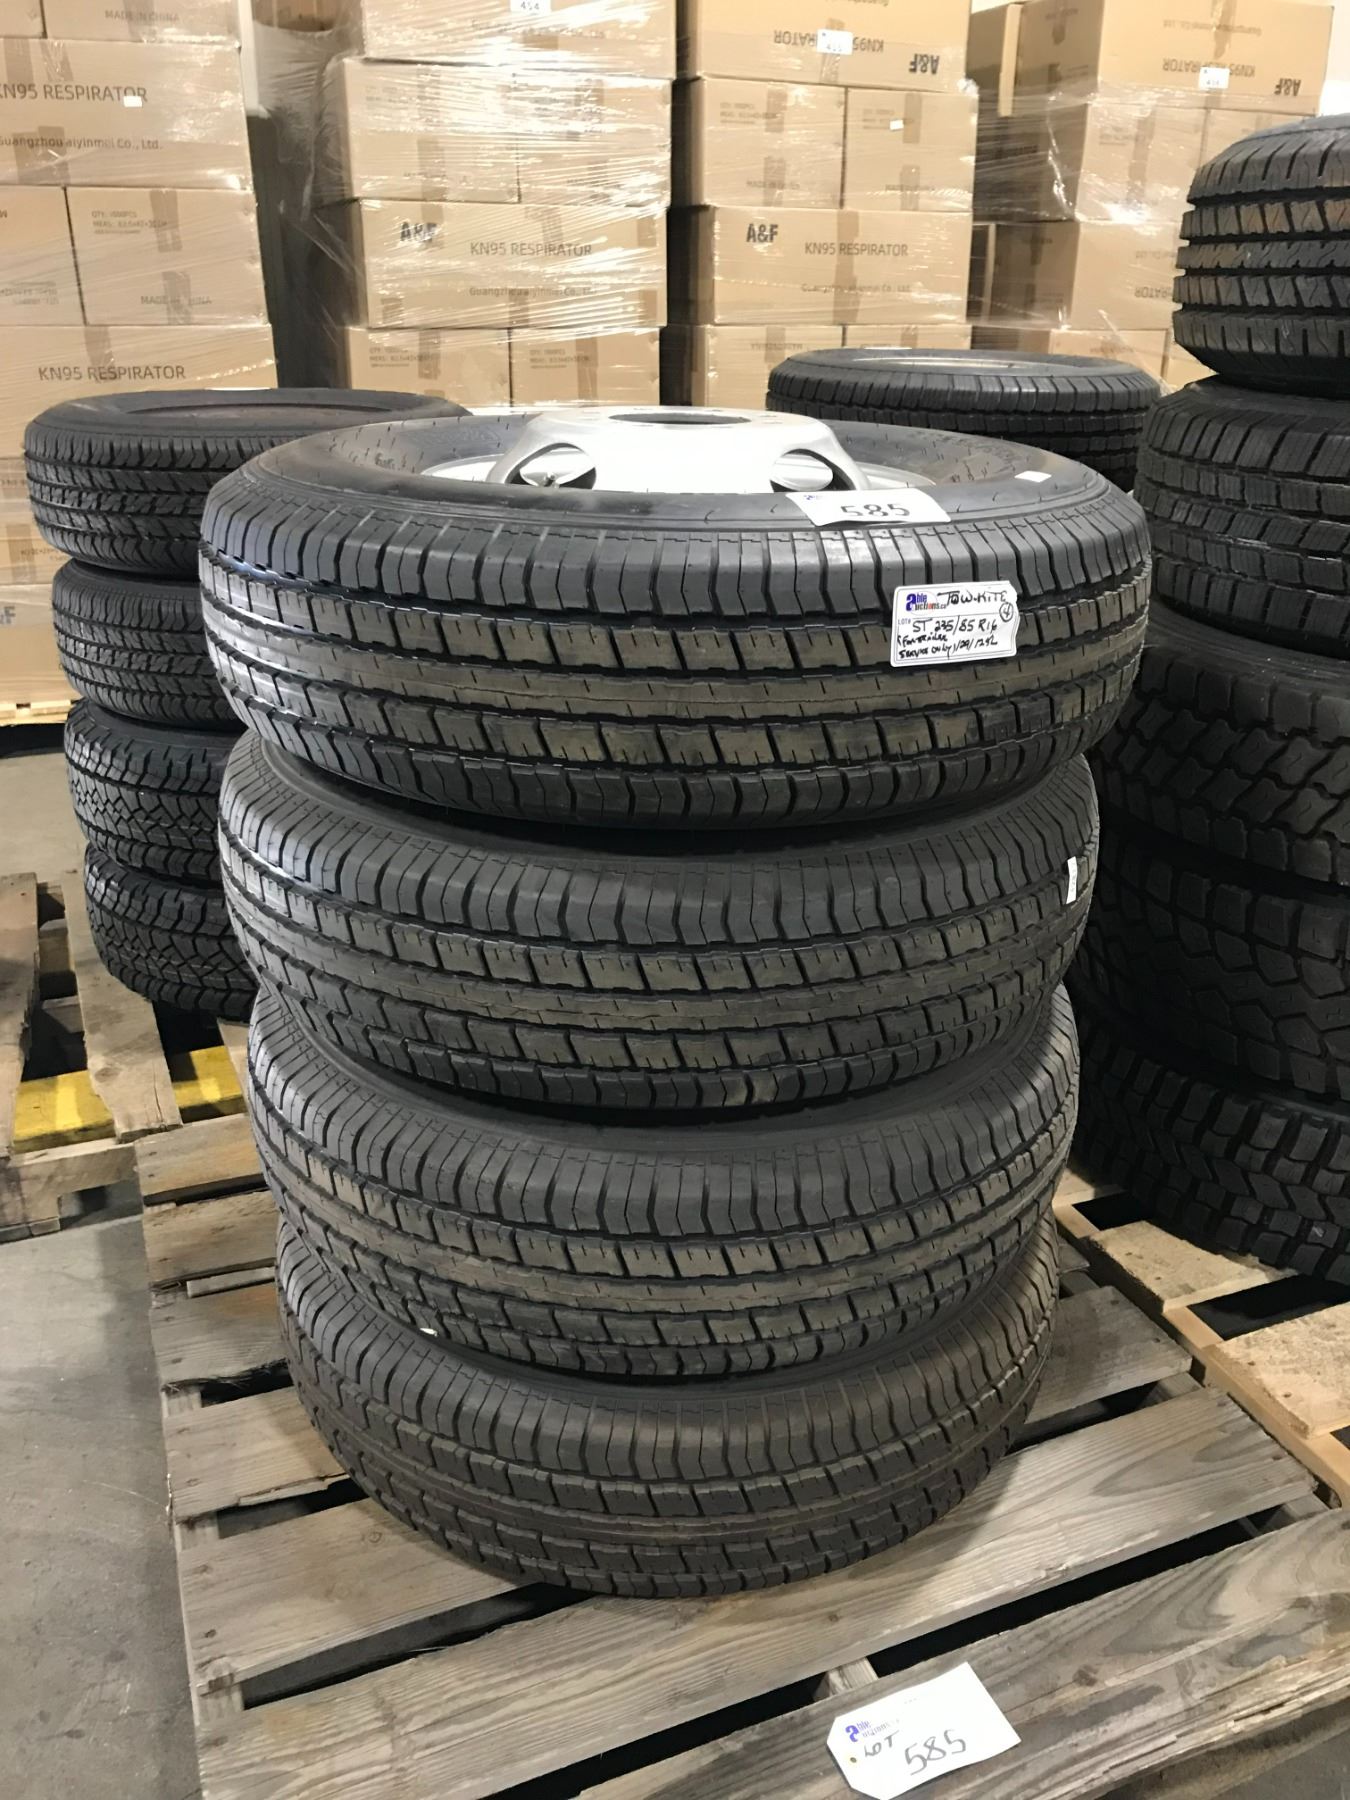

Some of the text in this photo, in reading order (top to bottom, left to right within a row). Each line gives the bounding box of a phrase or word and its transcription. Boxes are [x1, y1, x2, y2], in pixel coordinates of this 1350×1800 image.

[909, 53, 940, 75] A&F
[43, 84, 149, 102] RESPIRATOR
[1274, 78, 1302, 97] A&F
[746, 223, 779, 243] A&F
[470, 241, 592, 257] KN95 RESPIRATOR
[804, 242, 909, 257] KN95 RESPIRATOR
[38, 365, 187, 381] KN95 RESPIRATOR
[840, 503, 910, 517] 585
[912, 618, 933, 633] ST
[978, 618, 998, 634] R16
[864, 1729, 900, 1758] LOT
[904, 1729, 967, 1776] 585
